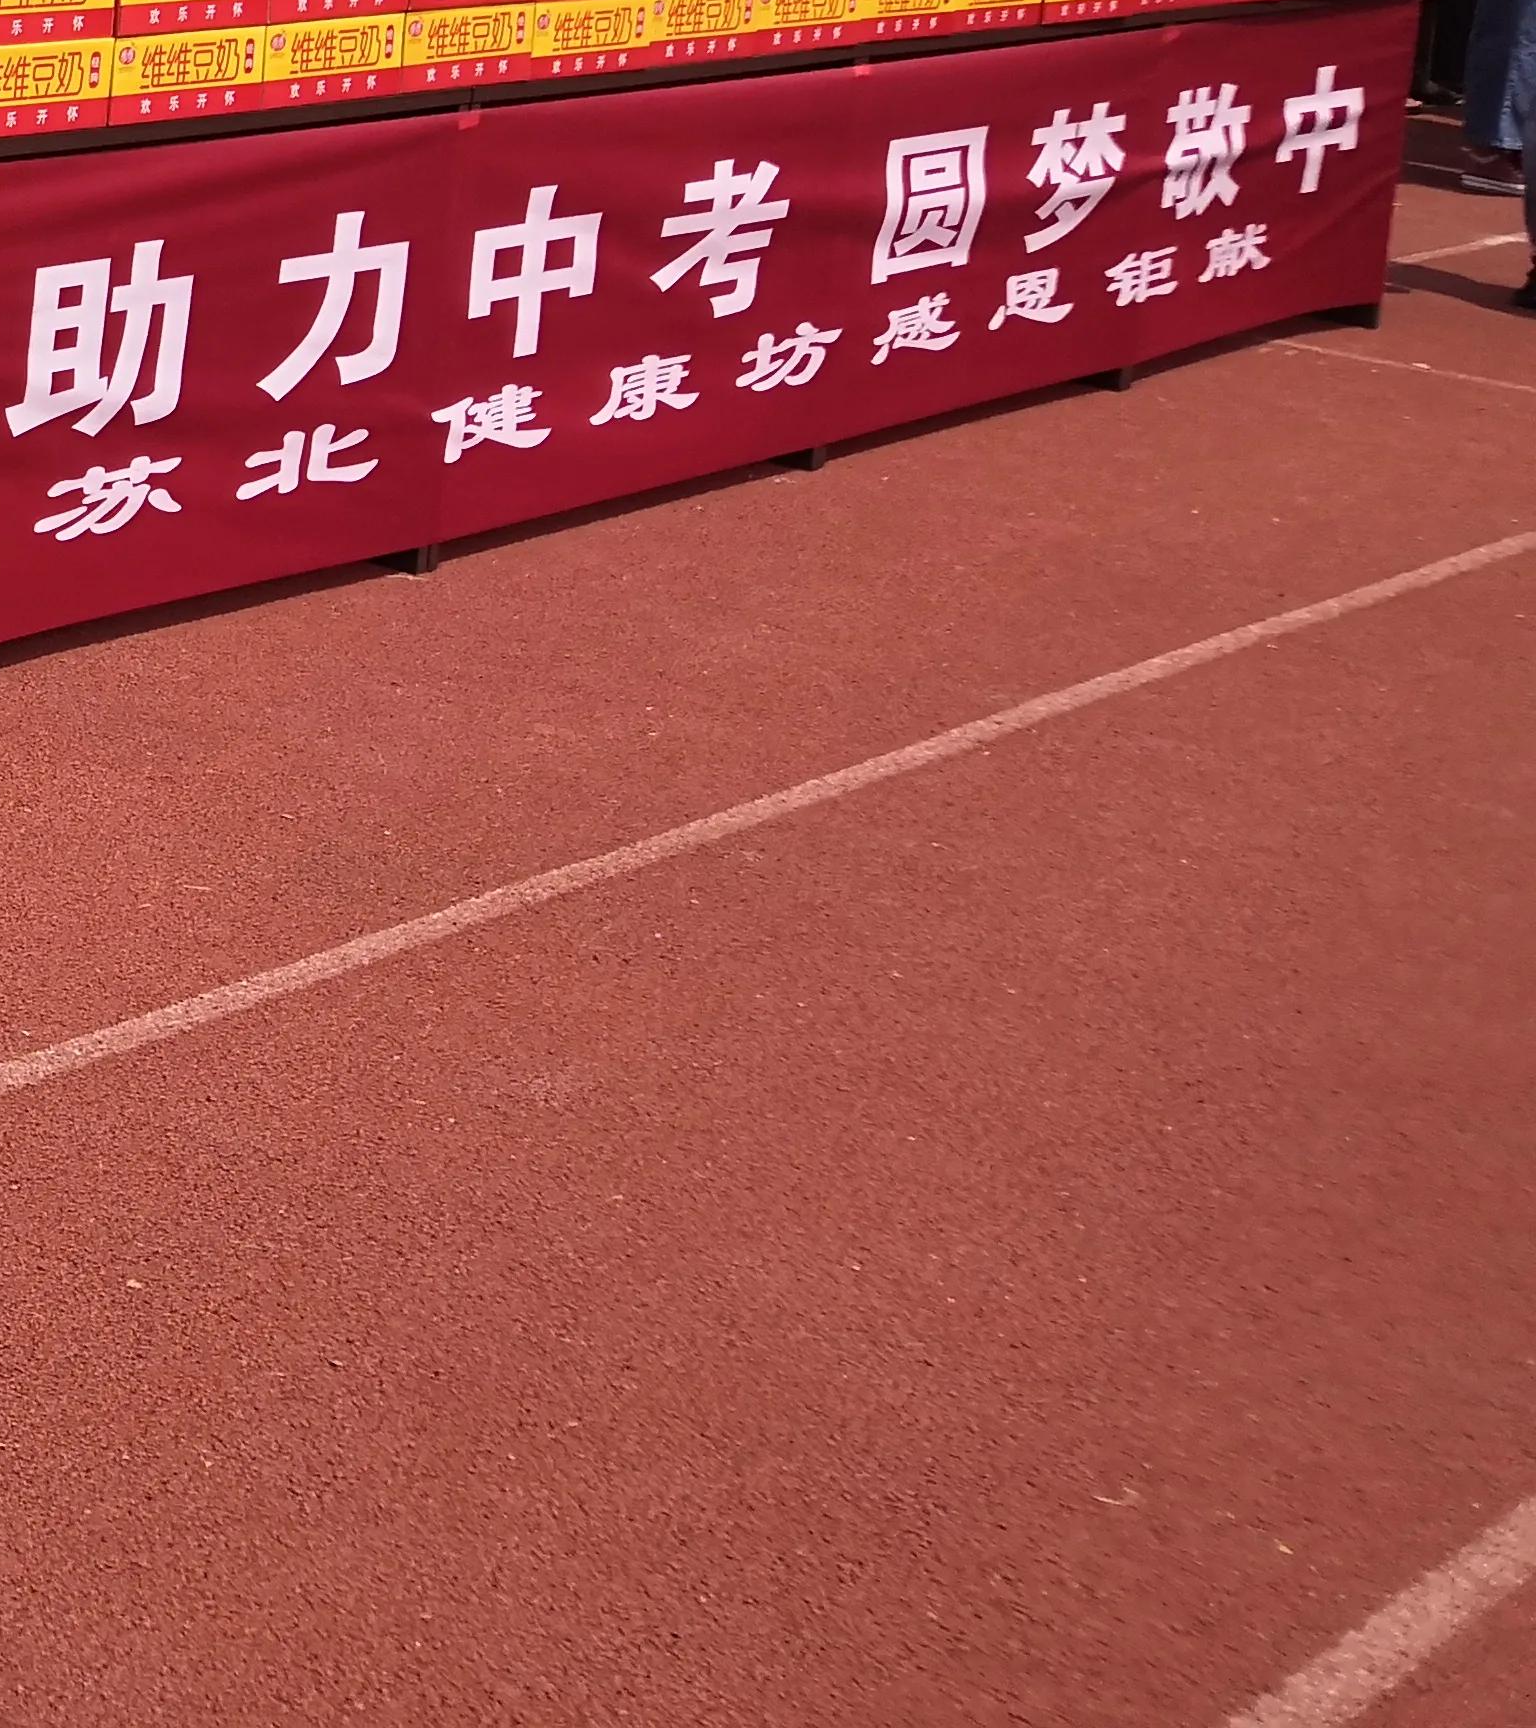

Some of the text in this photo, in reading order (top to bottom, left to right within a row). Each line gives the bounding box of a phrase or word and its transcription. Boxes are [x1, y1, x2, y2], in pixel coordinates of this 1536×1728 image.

[426, 10, 514, 59] 维维豆奶
[138, 37, 241, 90] 维维豆奶
[5, 65, 1366, 439] 助力中考 圆梦敬中
